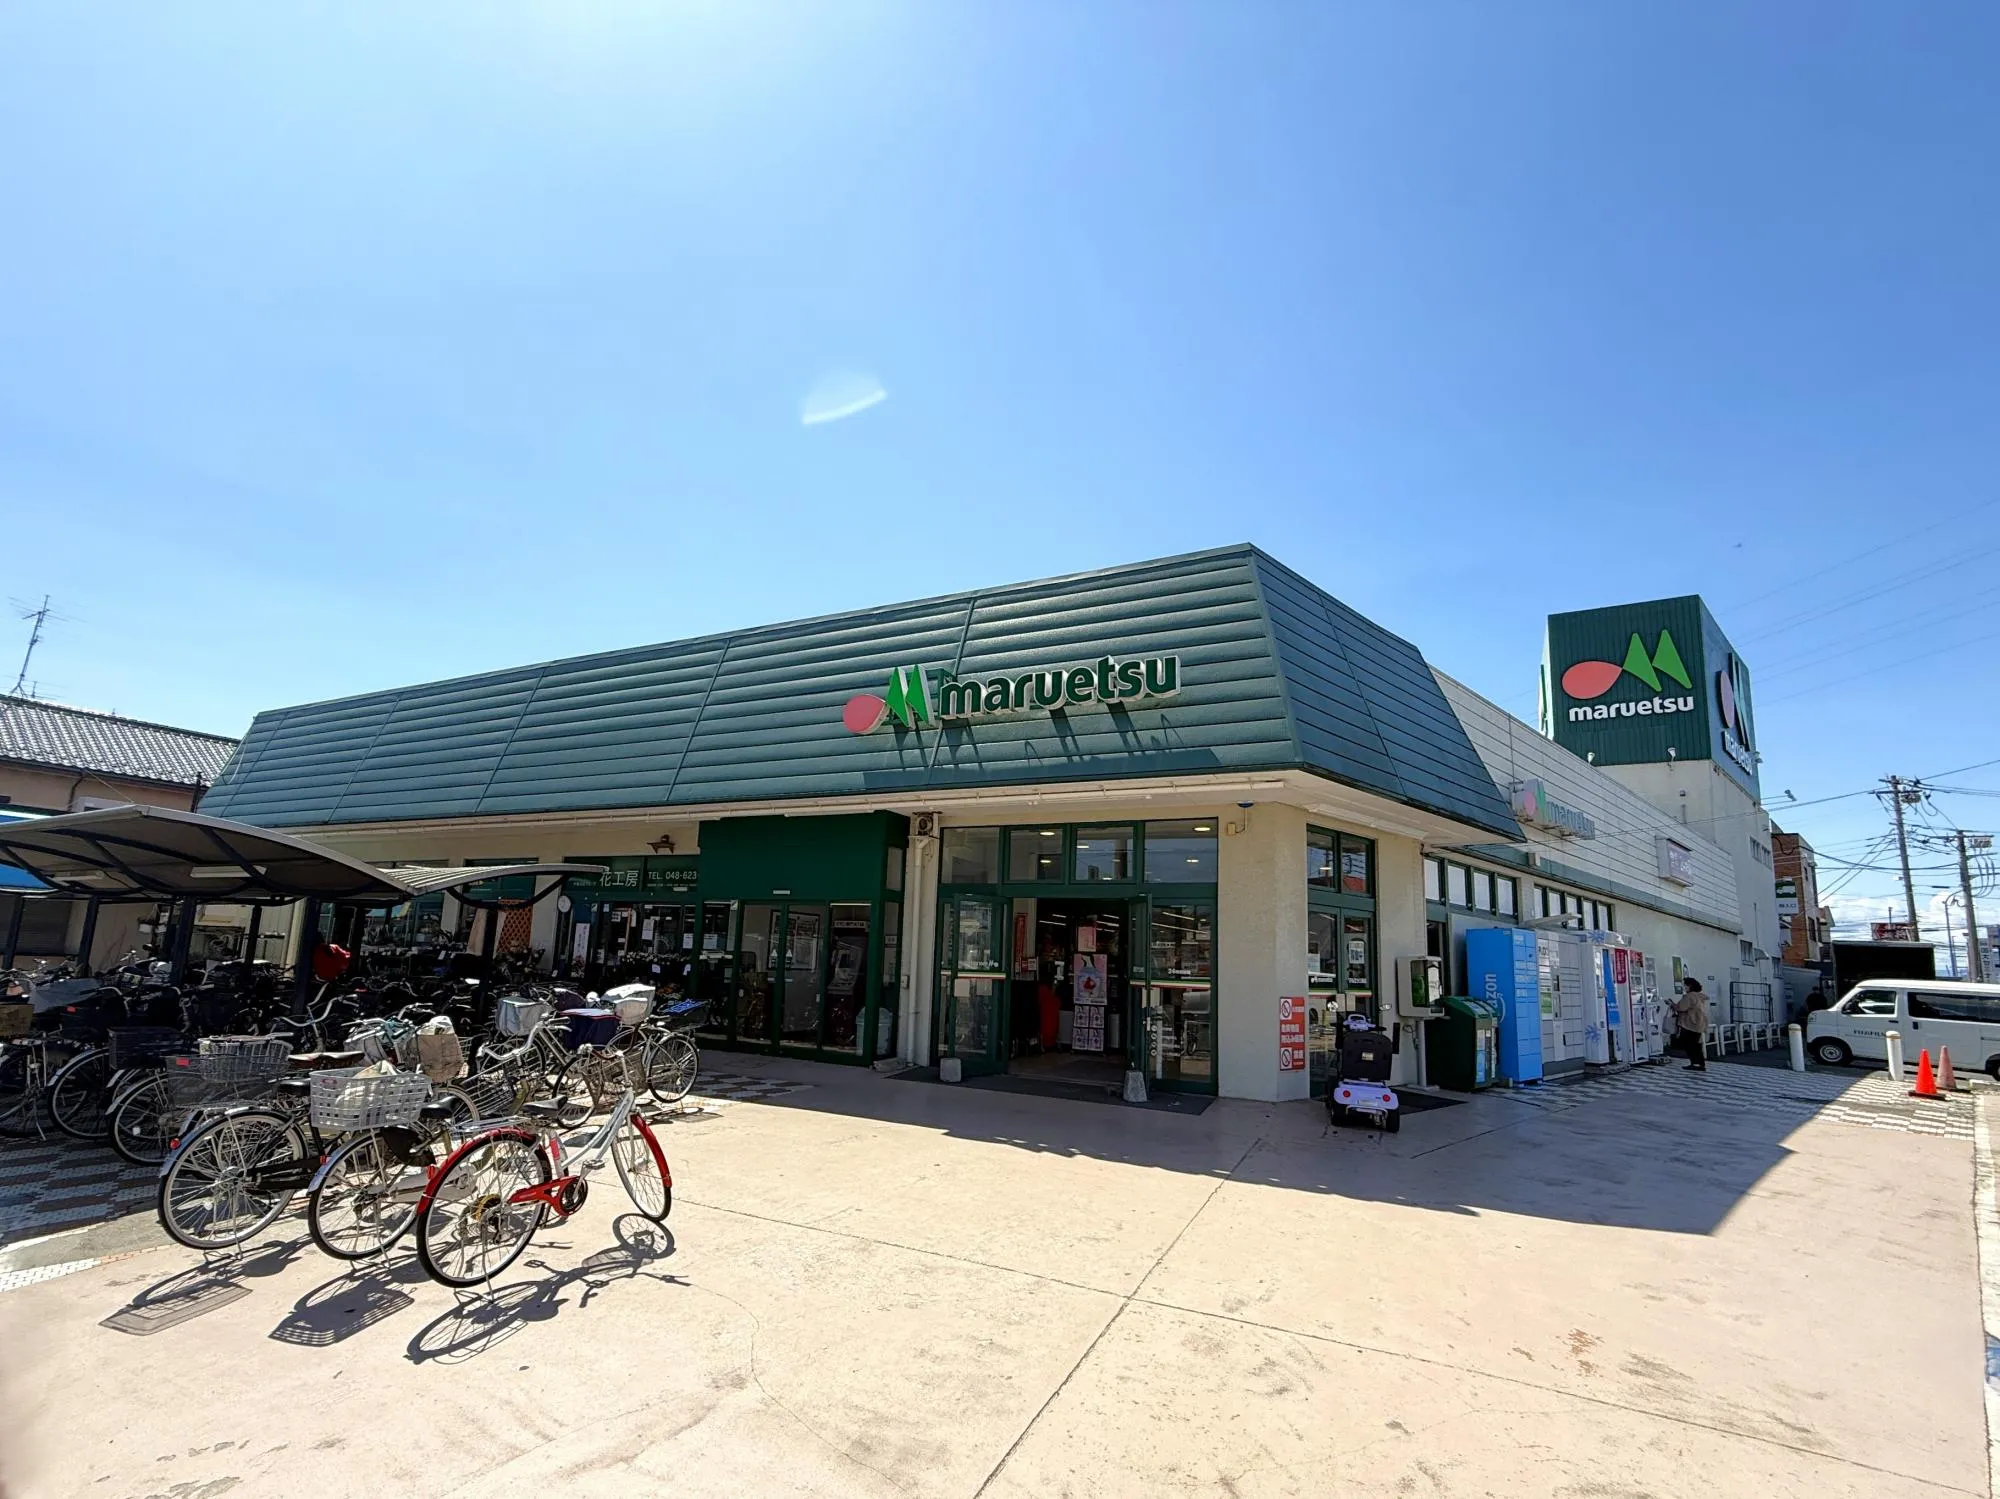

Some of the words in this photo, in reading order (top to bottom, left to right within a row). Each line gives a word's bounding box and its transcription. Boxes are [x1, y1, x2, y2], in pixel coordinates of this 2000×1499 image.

[940, 655, 1181, 719] maruetsu
[1568, 695, 1695, 722] maruetsu
[599, 870, 639, 888] 花工房
